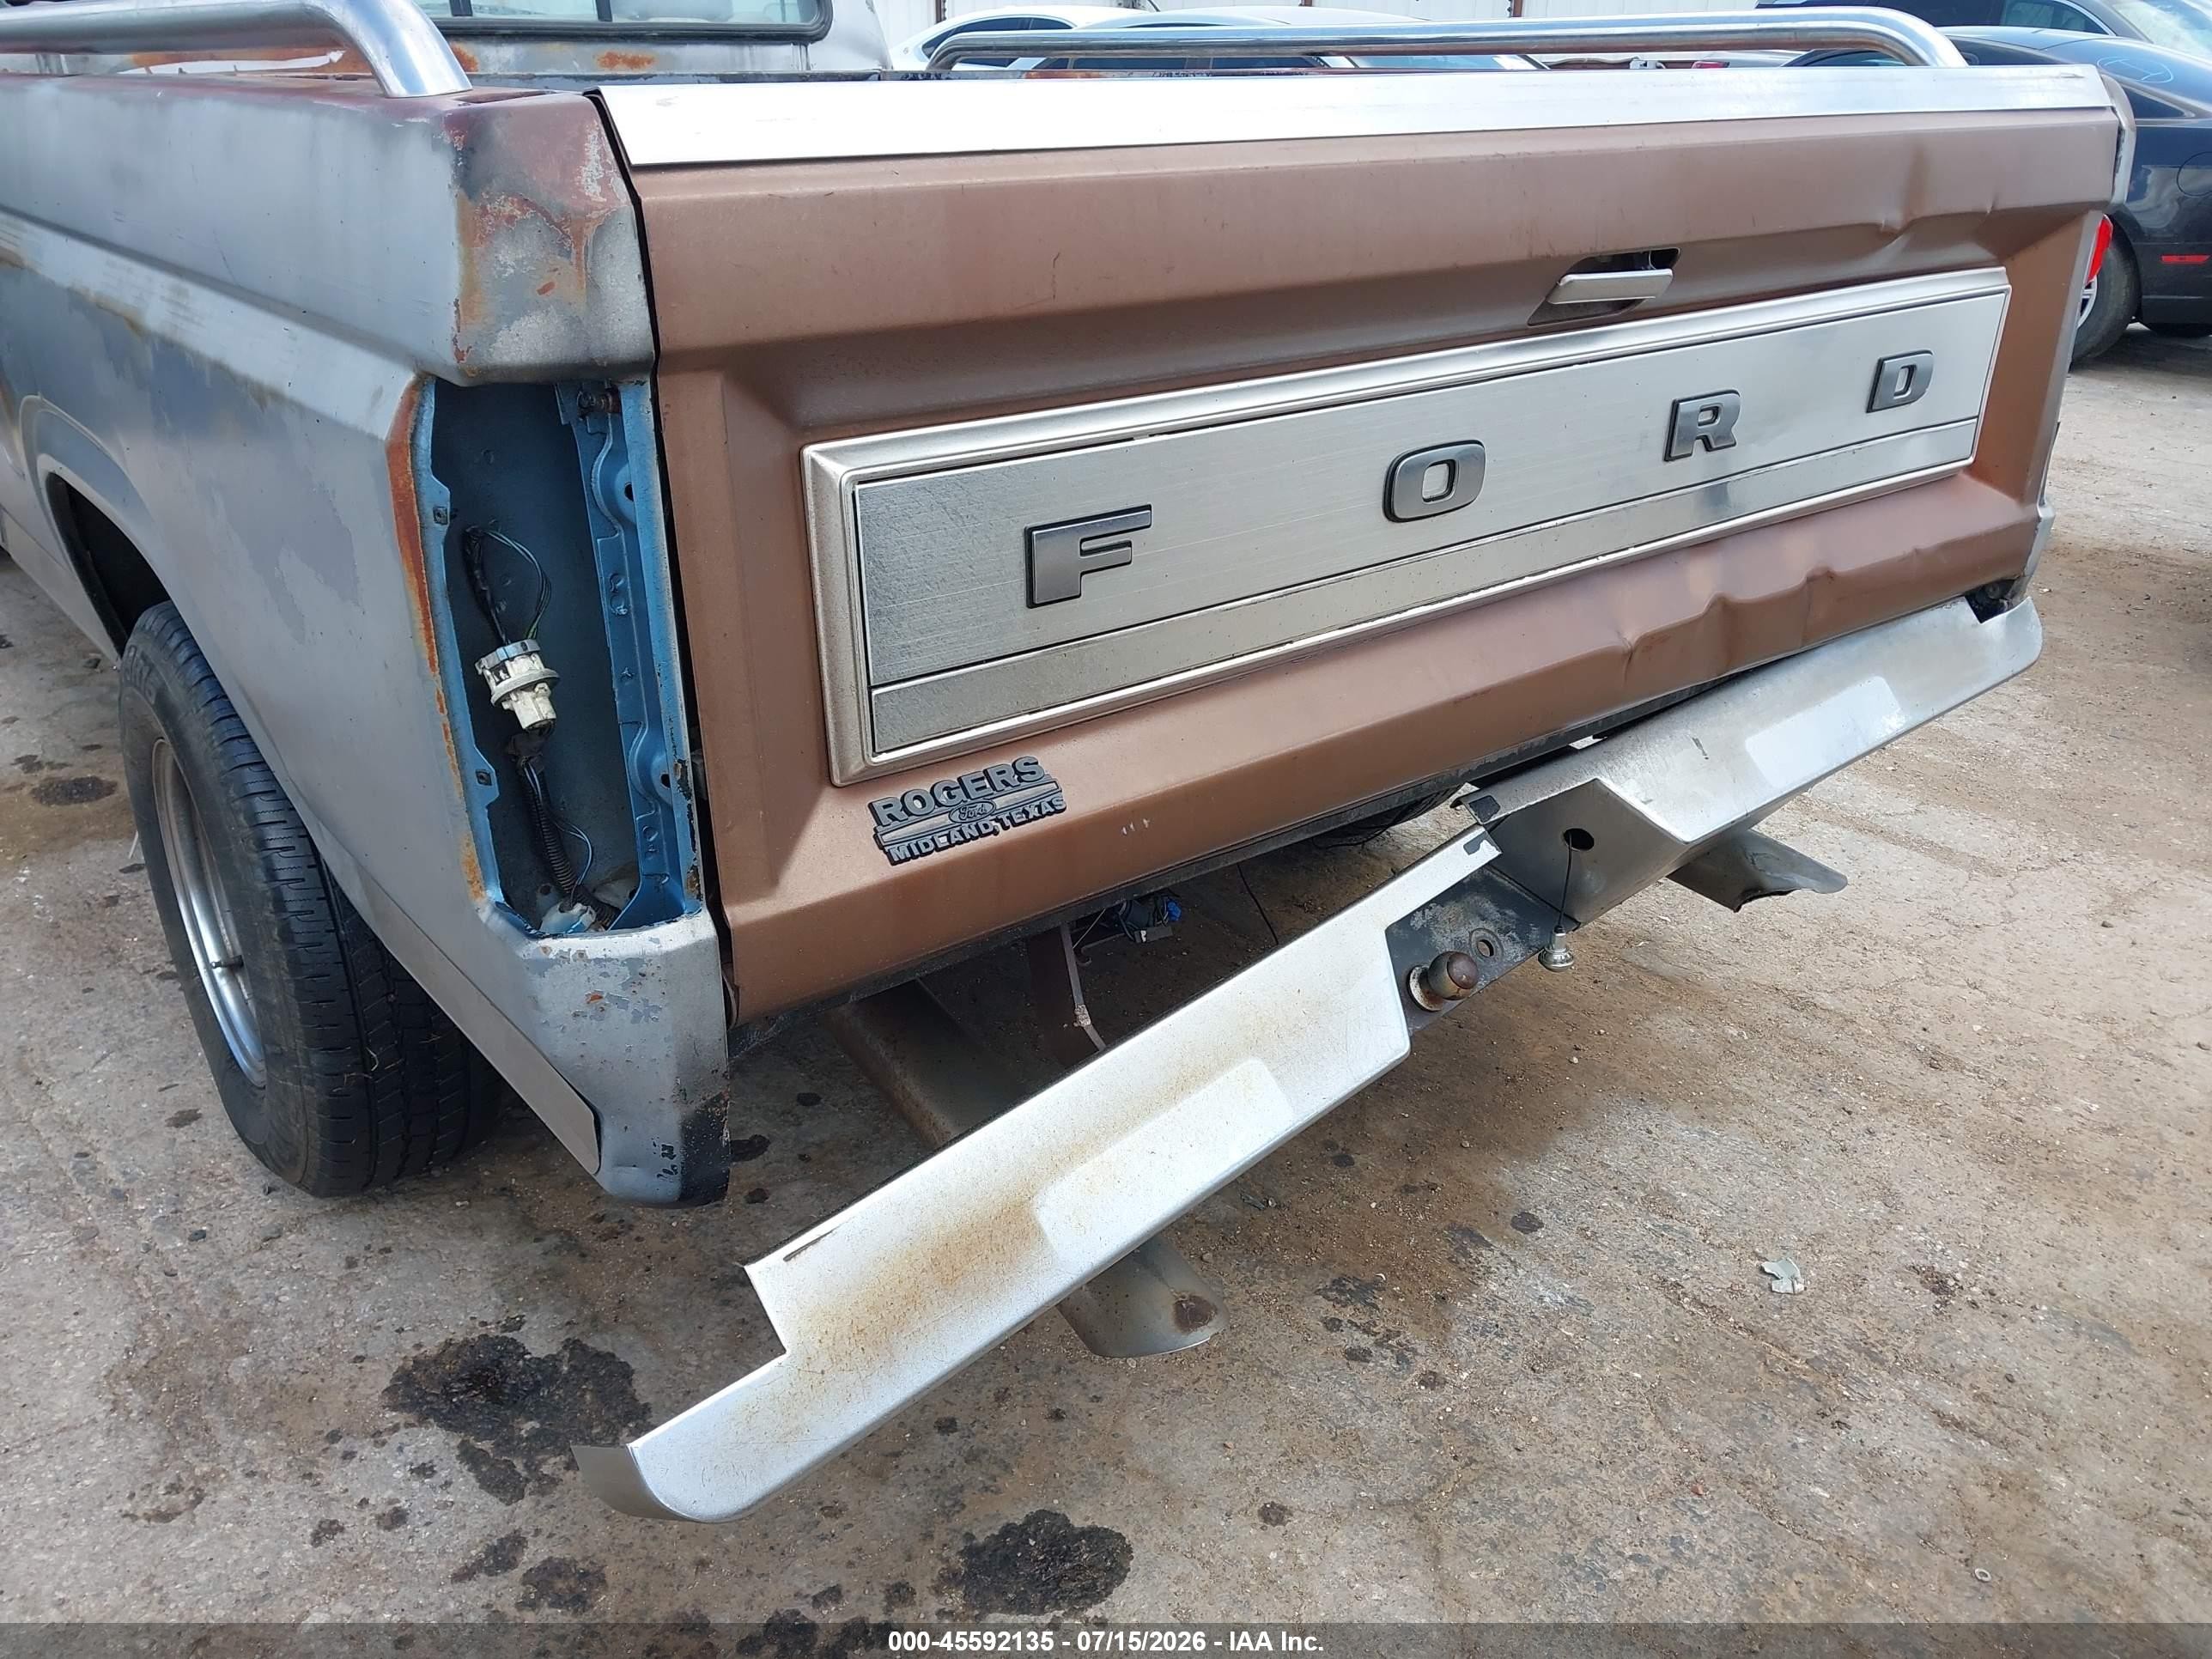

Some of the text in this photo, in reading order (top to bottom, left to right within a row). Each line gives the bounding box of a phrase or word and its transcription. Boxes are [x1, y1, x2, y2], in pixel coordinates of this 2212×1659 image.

[1024, 349, 1934, 609] FORD
[868, 756, 1045, 827] ROGERS
[995, 795, 1066, 832] TEXAS
